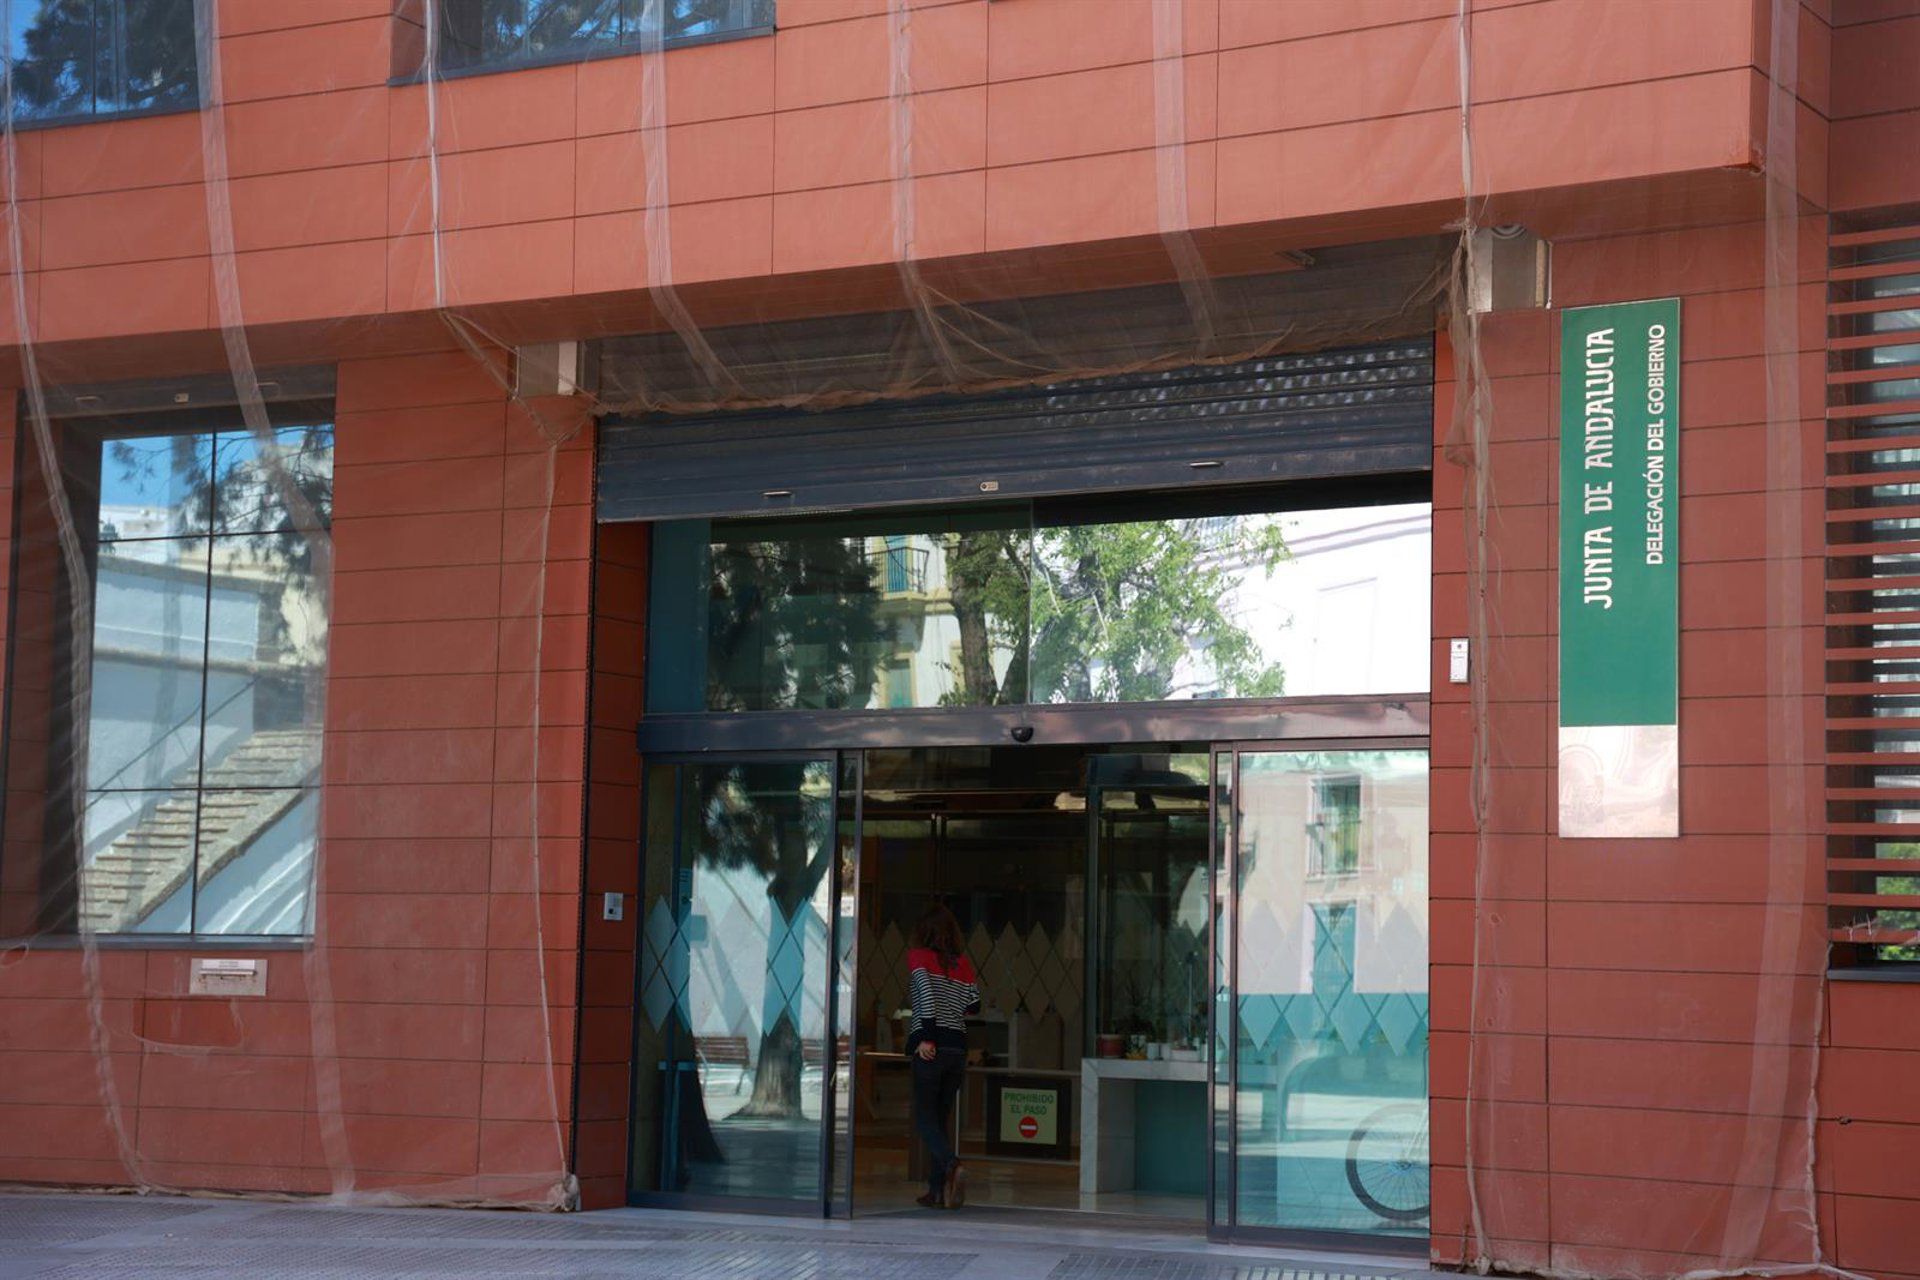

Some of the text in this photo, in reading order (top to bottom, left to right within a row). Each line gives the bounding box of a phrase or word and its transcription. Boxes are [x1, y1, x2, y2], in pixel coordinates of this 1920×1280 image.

[1642, 324, 1666, 565] DELEGACIÓN DEL GOBIERNO
[1584, 480, 1613, 515] DE
[1583, 525, 1613, 610] JUNTA
[1004, 1092, 1054, 1104] PROHIBIDO
[1008, 1104, 1047, 1115] EL PASO
